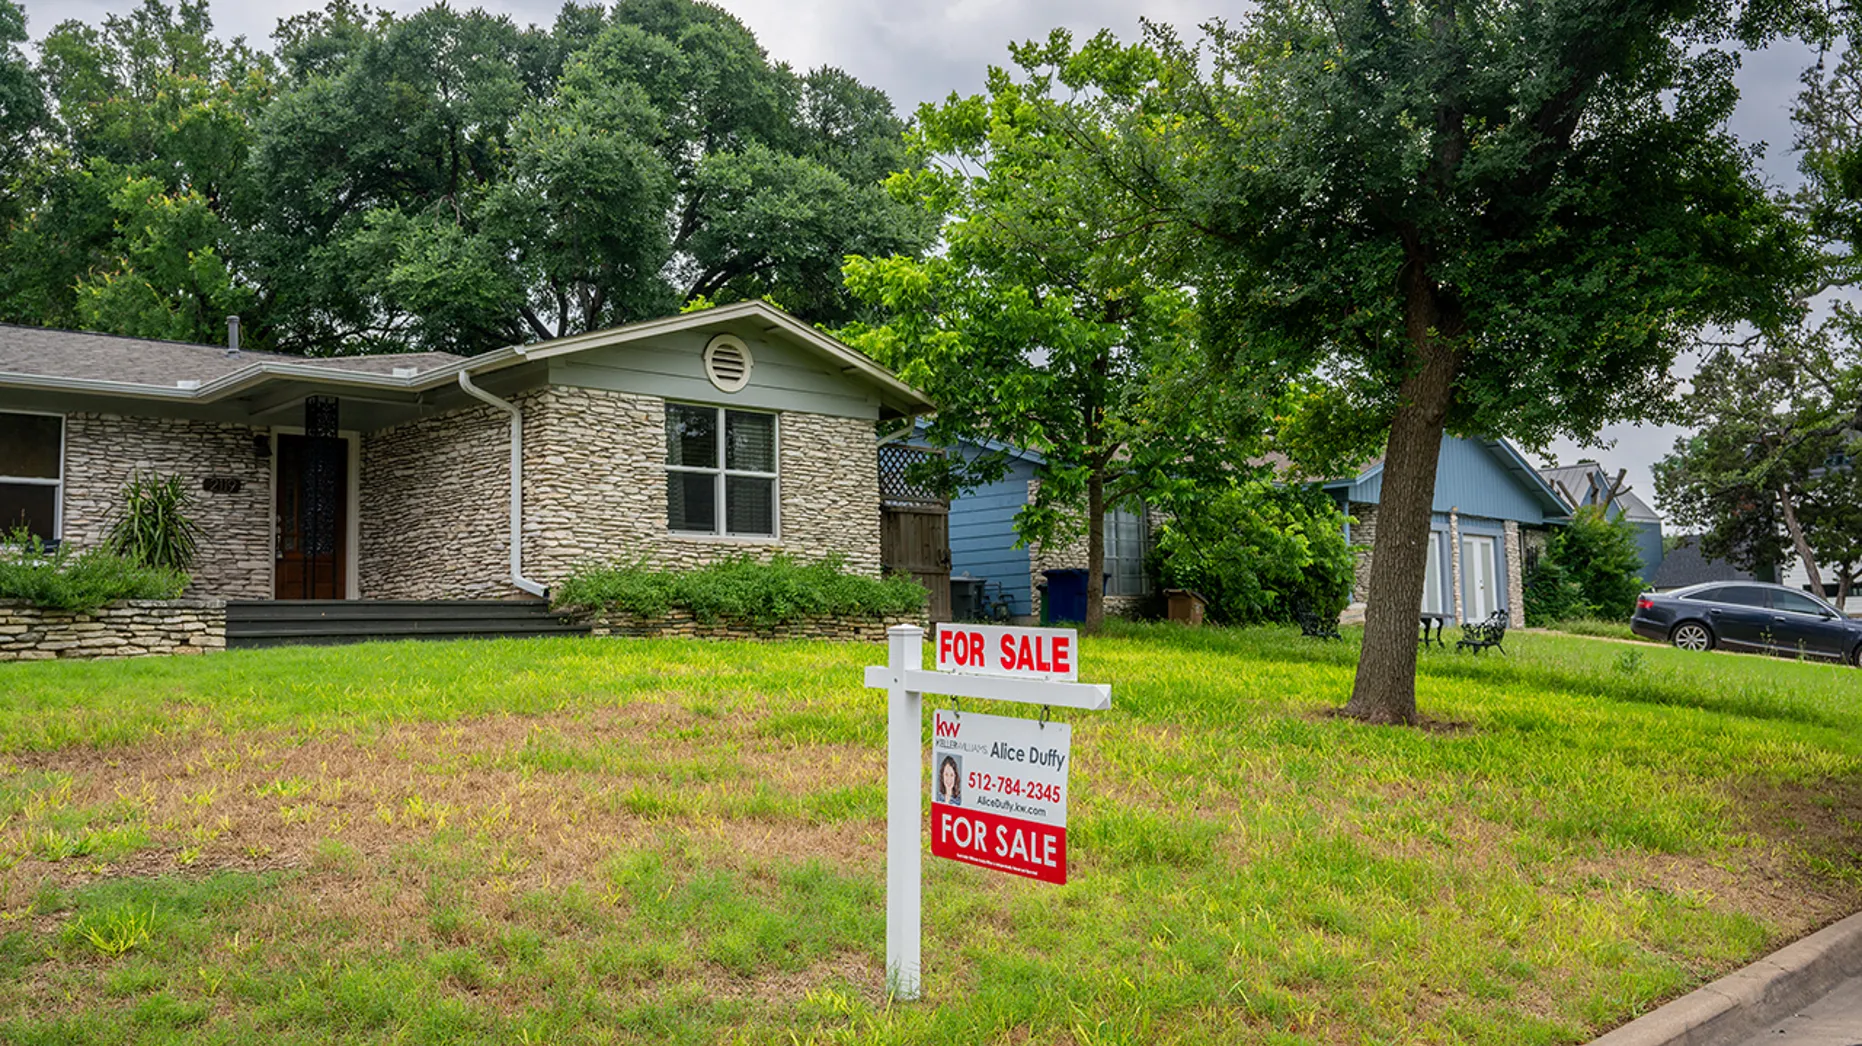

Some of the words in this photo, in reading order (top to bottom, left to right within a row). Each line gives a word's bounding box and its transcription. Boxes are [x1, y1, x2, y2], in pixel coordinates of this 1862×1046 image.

[209, 478, 237, 492] 2119
[940, 630, 985, 667] FOR
[1000, 633, 1070, 673] SALE
[936, 713, 960, 738] kw
[990, 741, 1025, 762] Alice
[1029, 747, 1066, 772] Duffy
[968, 772, 1061, 803] 512-784-2345
[976, 796, 1046, 817] AliceDuffy.kw.com
[941, 813, 987, 852] FOR
[995, 825, 1057, 867] SALE
